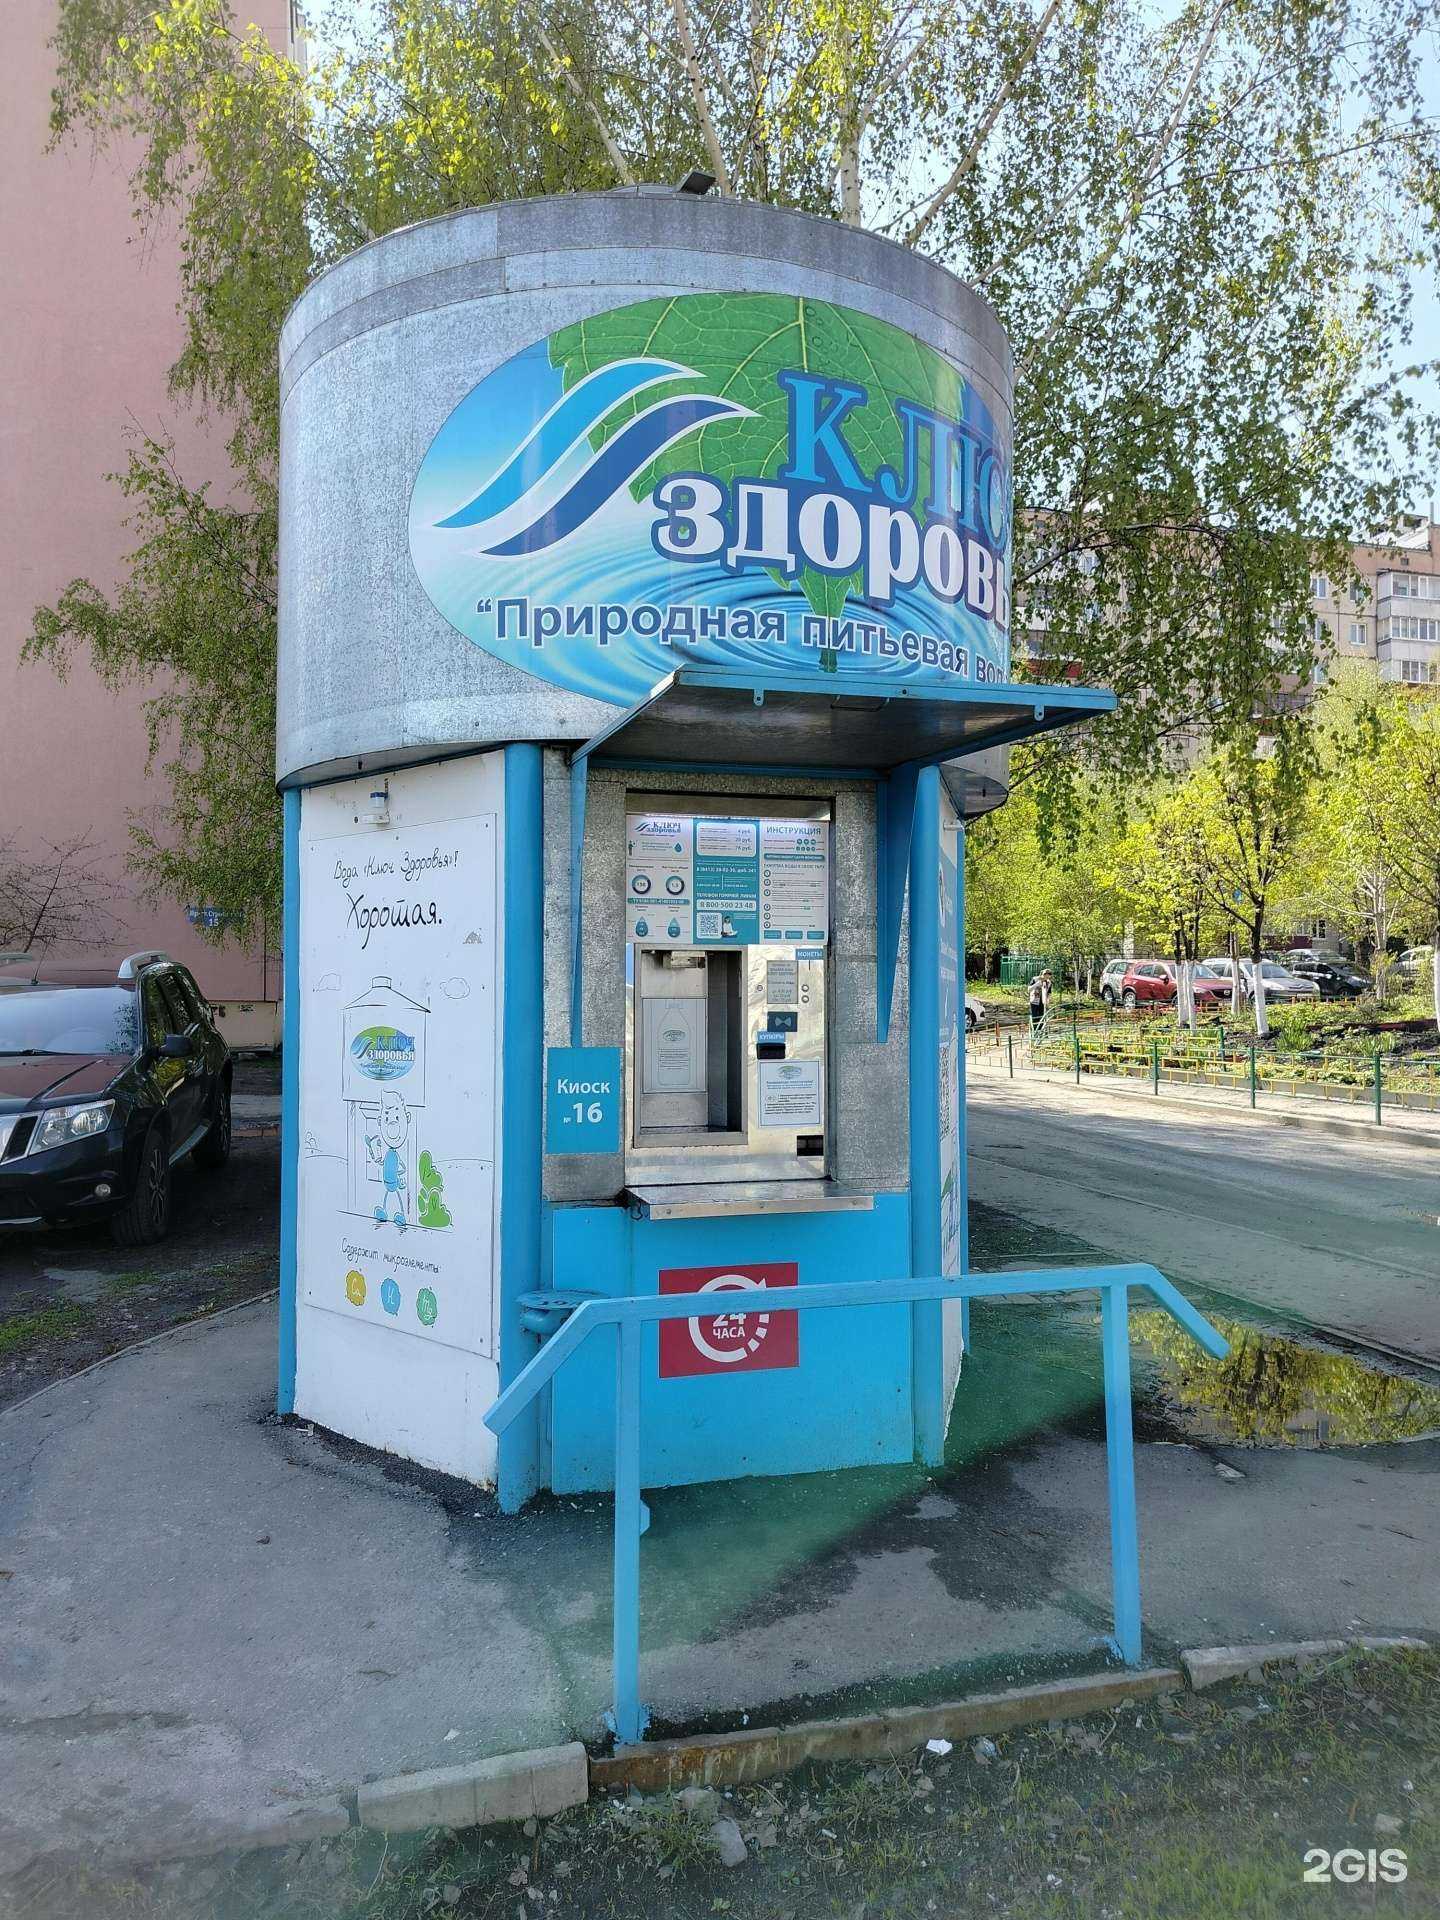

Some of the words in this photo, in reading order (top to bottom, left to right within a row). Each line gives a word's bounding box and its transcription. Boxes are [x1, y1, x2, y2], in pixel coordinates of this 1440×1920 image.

[802, 614, 968, 677] питьевая
[766, 826, 821, 835] ИНСТРУКЦИЯ
[333, 860, 359, 888] Вода
[557, 1079, 610, 1094] Киоск
[572, 1102, 603, 1123] 16
[341, 1237, 379, 1263] Содержит
[382, 1252, 440, 1274] микроэлементы
[712, 1326, 746, 1340] ЧАСА
